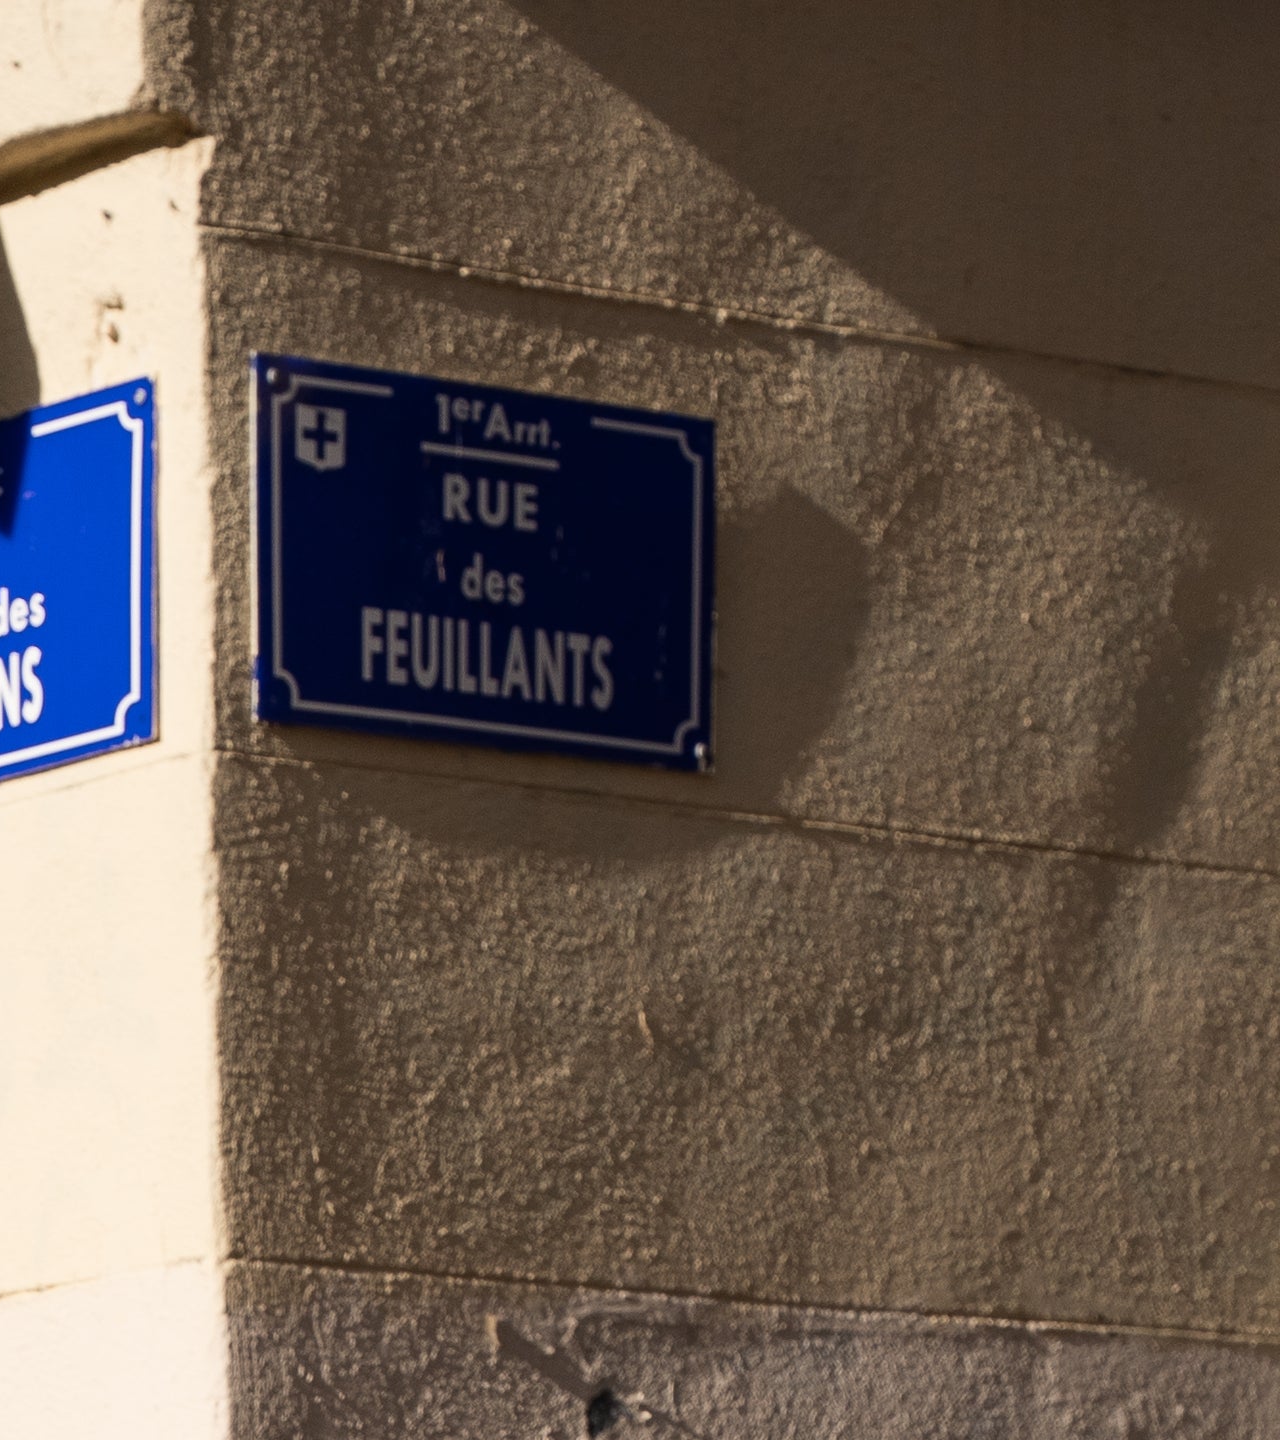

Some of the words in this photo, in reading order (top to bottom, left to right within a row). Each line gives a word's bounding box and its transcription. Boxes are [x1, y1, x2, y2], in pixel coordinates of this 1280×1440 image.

[443, 473, 539, 533] RUE
[460, 552, 525, 606] des
[359, 606, 614, 710] FEUILLANTS
